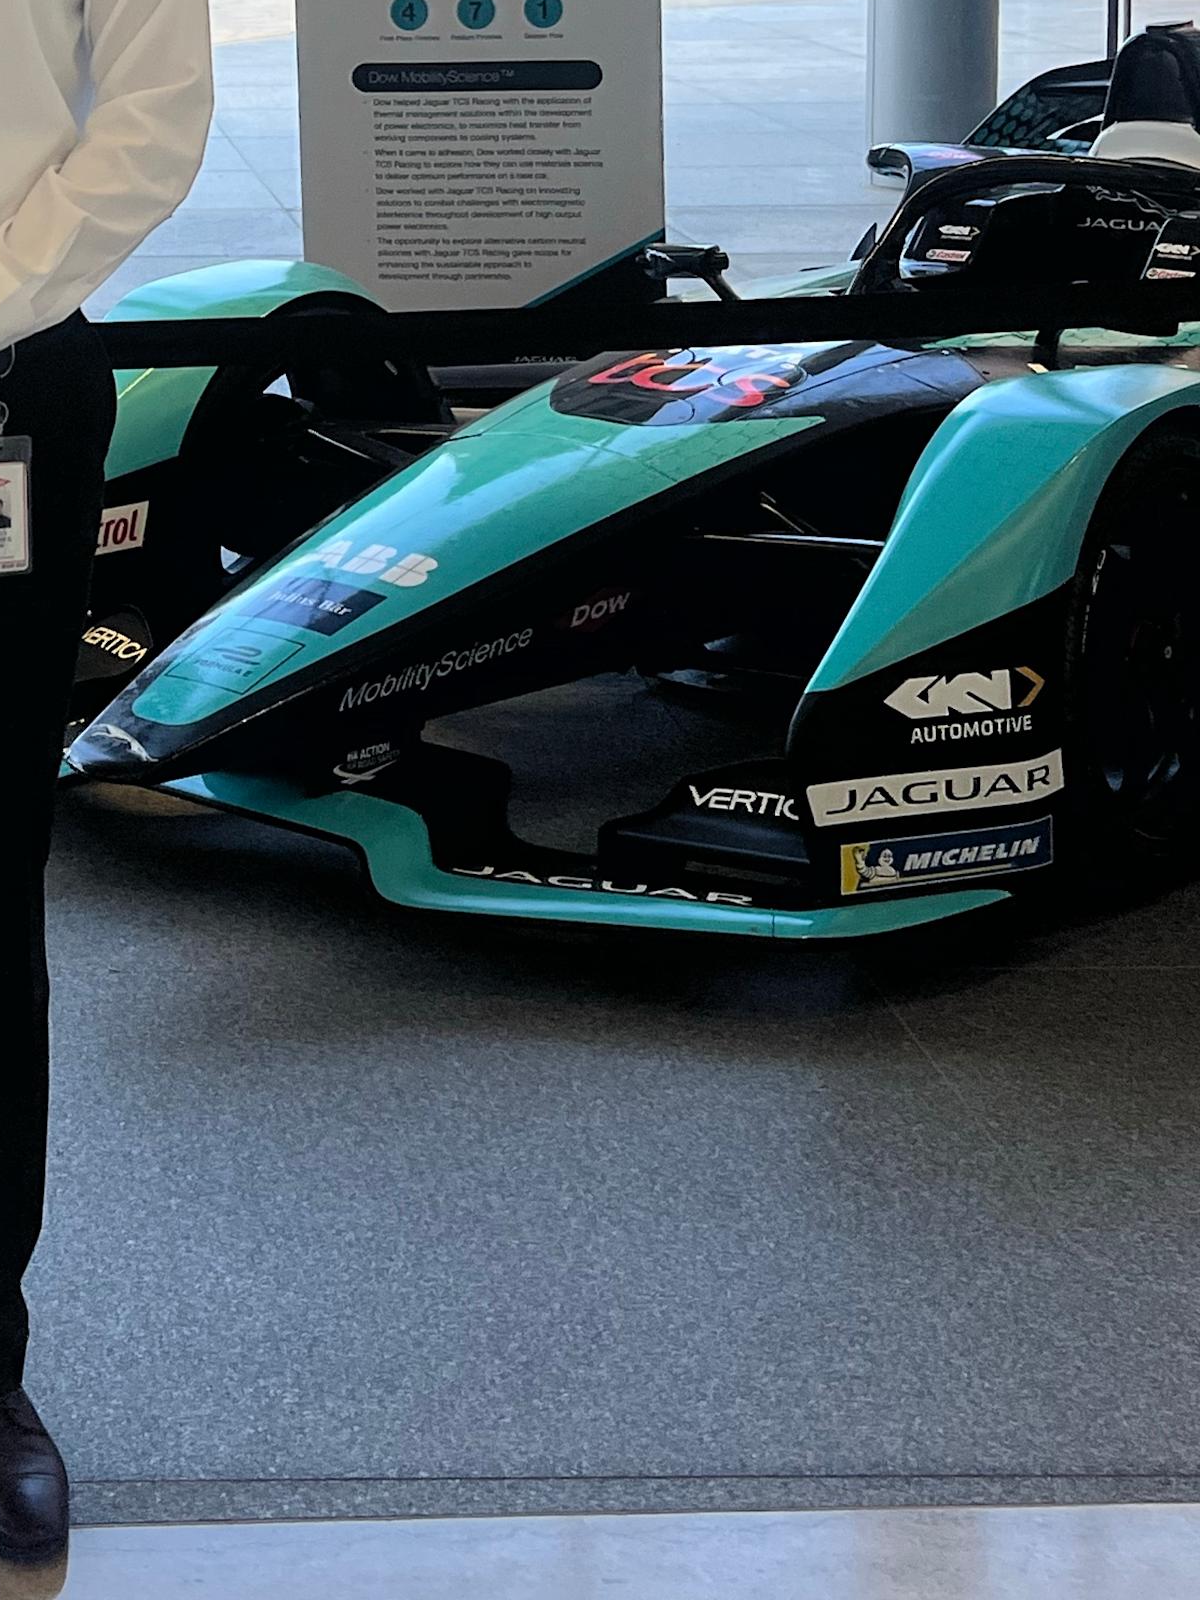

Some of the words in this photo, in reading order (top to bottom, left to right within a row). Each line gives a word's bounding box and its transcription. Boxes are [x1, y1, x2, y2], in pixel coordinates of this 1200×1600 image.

[401, 2, 416, 22] 4
[469, 1, 482, 20] 7
[538, 0, 548, 20] 1
[368, 71, 398, 84] Dow
[1077, 217, 1161, 232] JAGUA
[313, 540, 439, 588] ABB
[268, 590, 316, 607] Julius
[318, 598, 353, 616] Bär
[338, 628, 534, 712] MobilityScience
[910, 714, 1032, 744] AUTOMOTIVE
[360, 740, 390, 760] ACTION
[826, 764, 1050, 815] JAGUAR
[904, 836, 1041, 872] MICHELIN
[452, 866, 752, 906] JAGUAR
